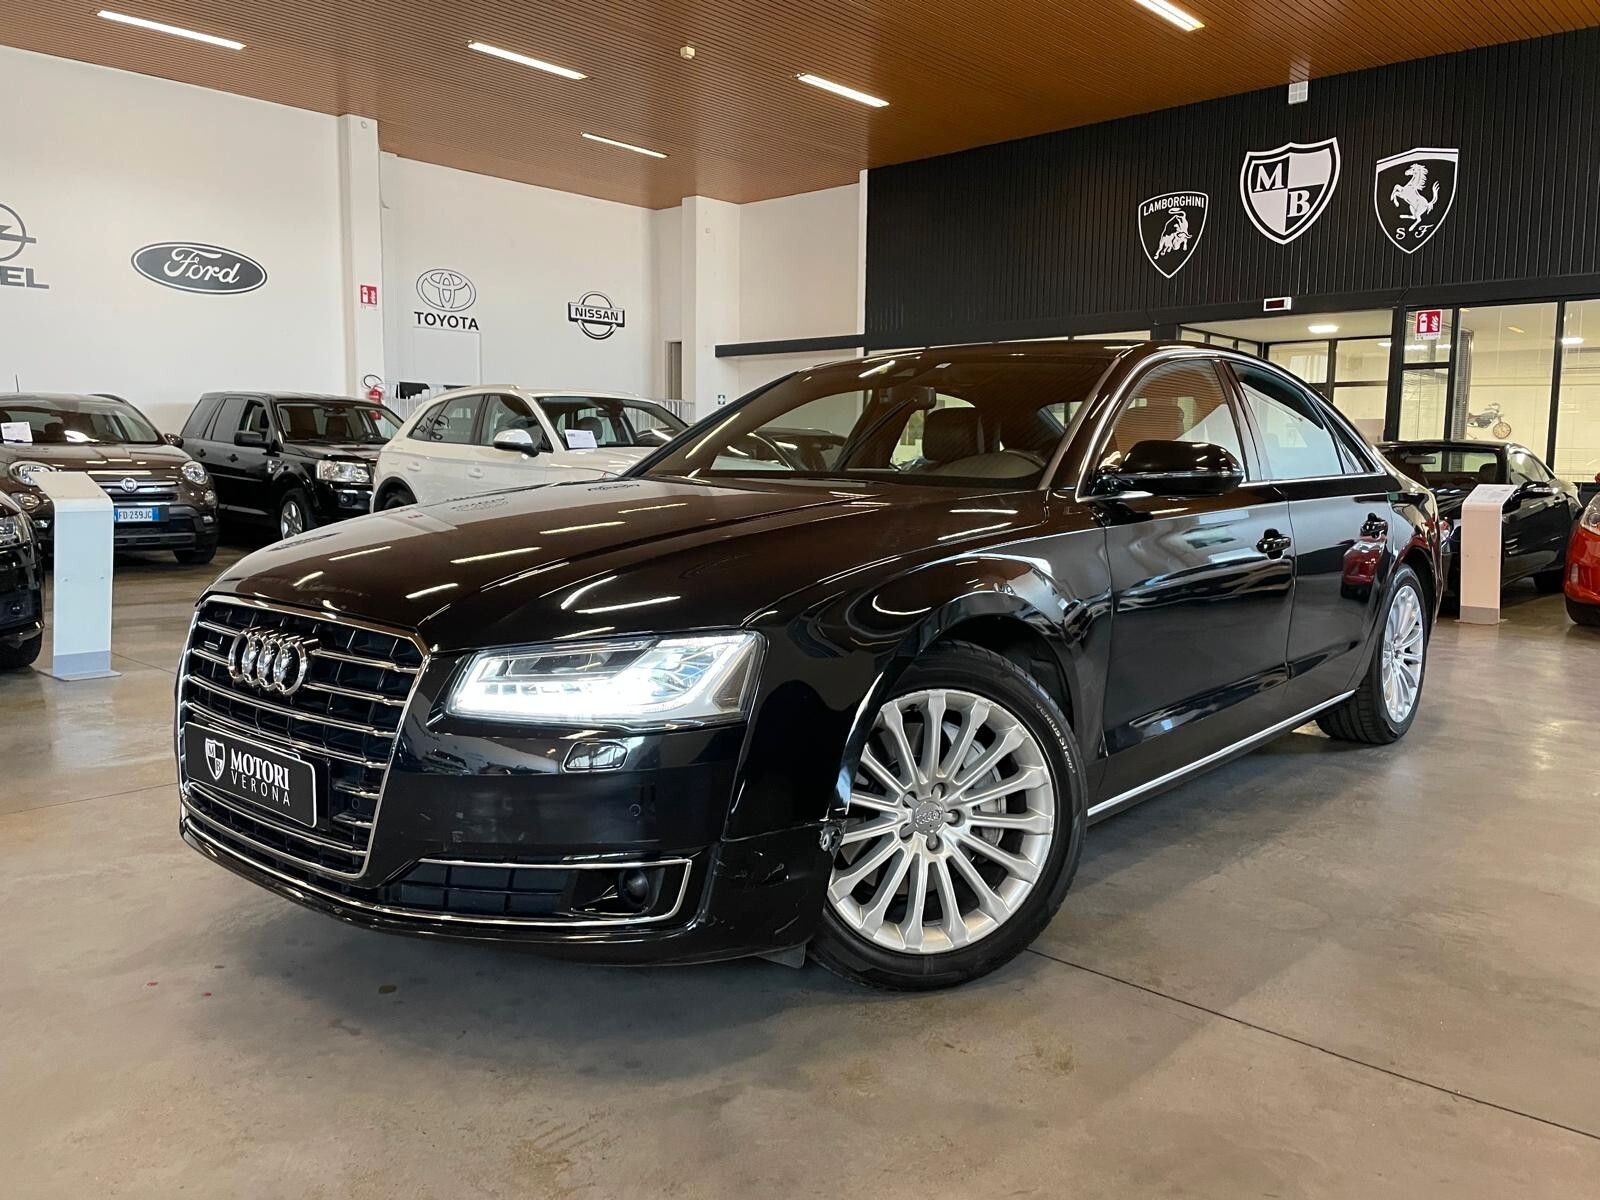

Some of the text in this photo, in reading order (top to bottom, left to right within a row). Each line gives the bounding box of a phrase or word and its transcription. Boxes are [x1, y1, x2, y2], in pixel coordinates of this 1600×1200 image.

[1143, 194, 1205, 217] LAMBORGHINI
[1254, 165, 1311, 217] M B
[1395, 227, 1406, 240] S
[163, 247, 241, 284] Ford
[414, 311, 480, 331] TOYOTA
[575, 306, 619, 322] NISSAN
[230, 748, 290, 790] MOTORI
[230, 770, 291, 806] VERONA
